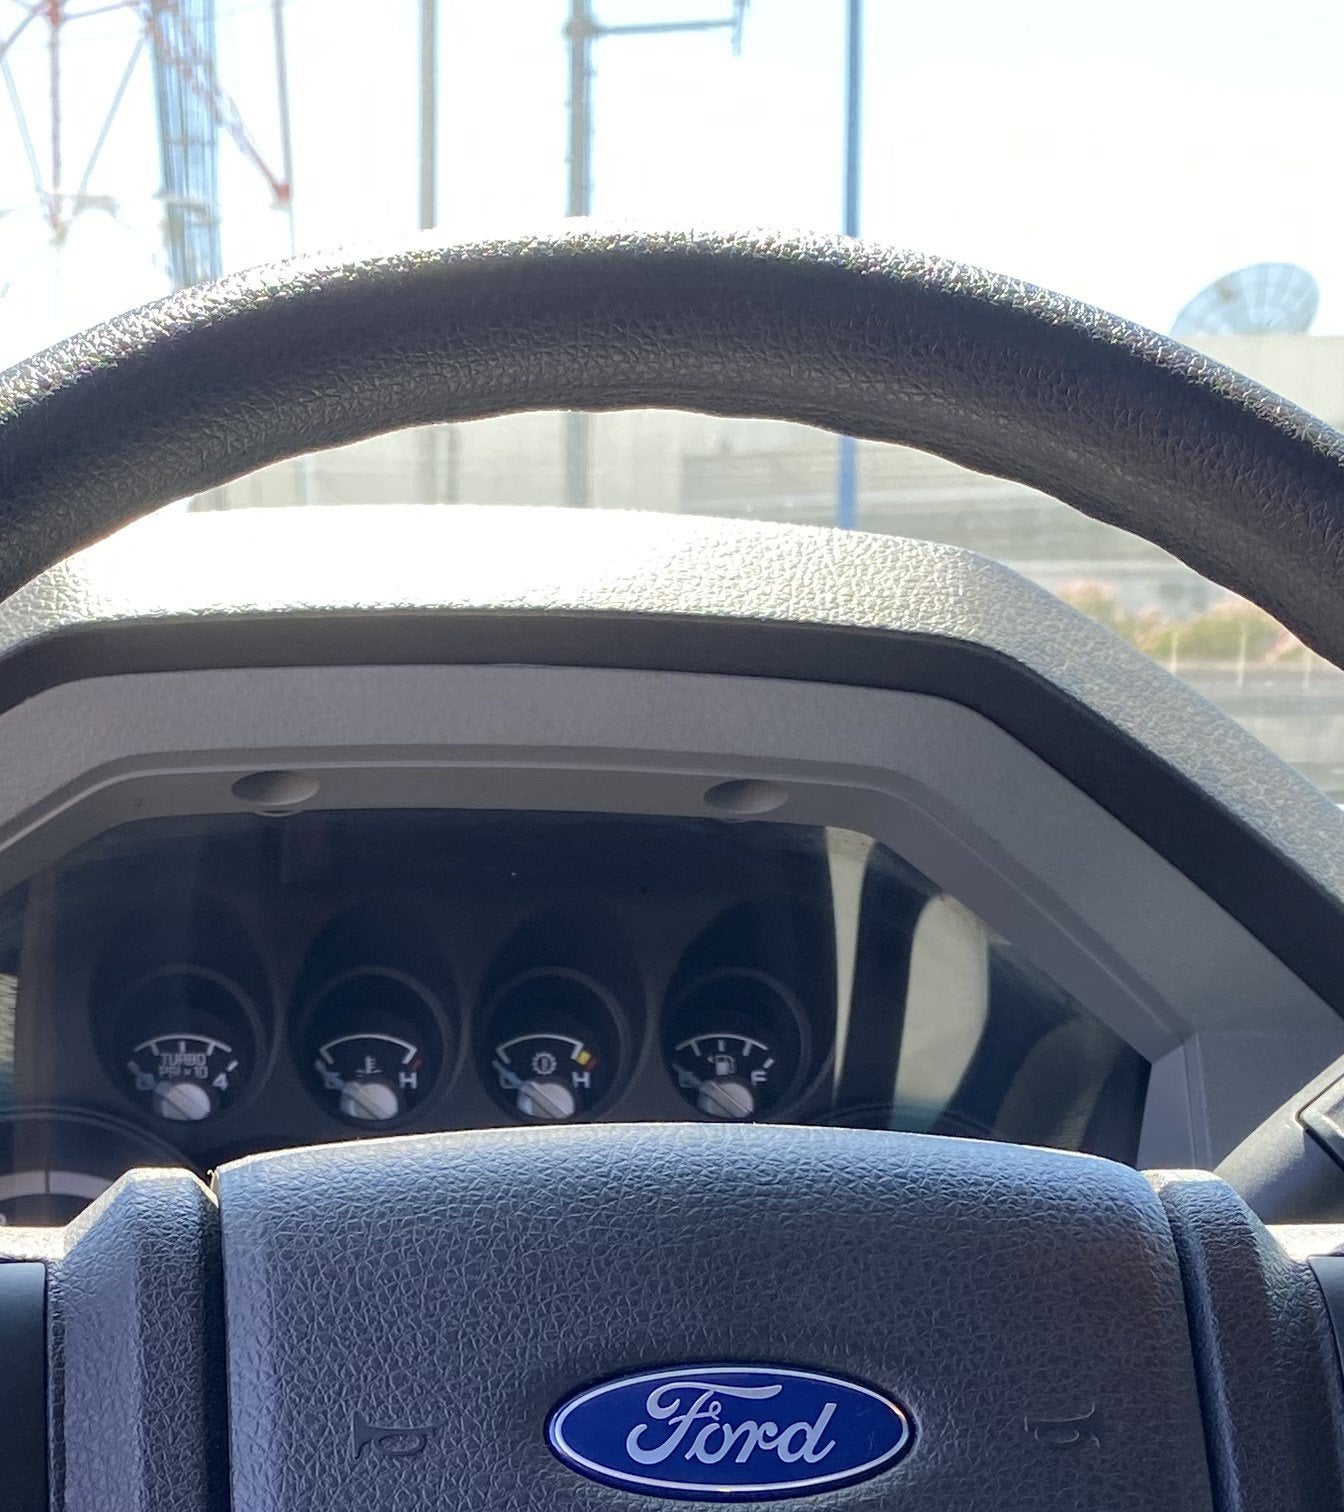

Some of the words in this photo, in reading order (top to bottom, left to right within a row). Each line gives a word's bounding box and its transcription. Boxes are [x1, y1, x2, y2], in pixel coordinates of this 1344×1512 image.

[159, 1053, 206, 1066] TURBO
[212, 1073, 229, 1091] 4
[398, 1071, 418, 1089] H
[572, 1071, 591, 1089] H
[750, 1070, 767, 1087] F
[626, 1381, 838, 1466] Ford
